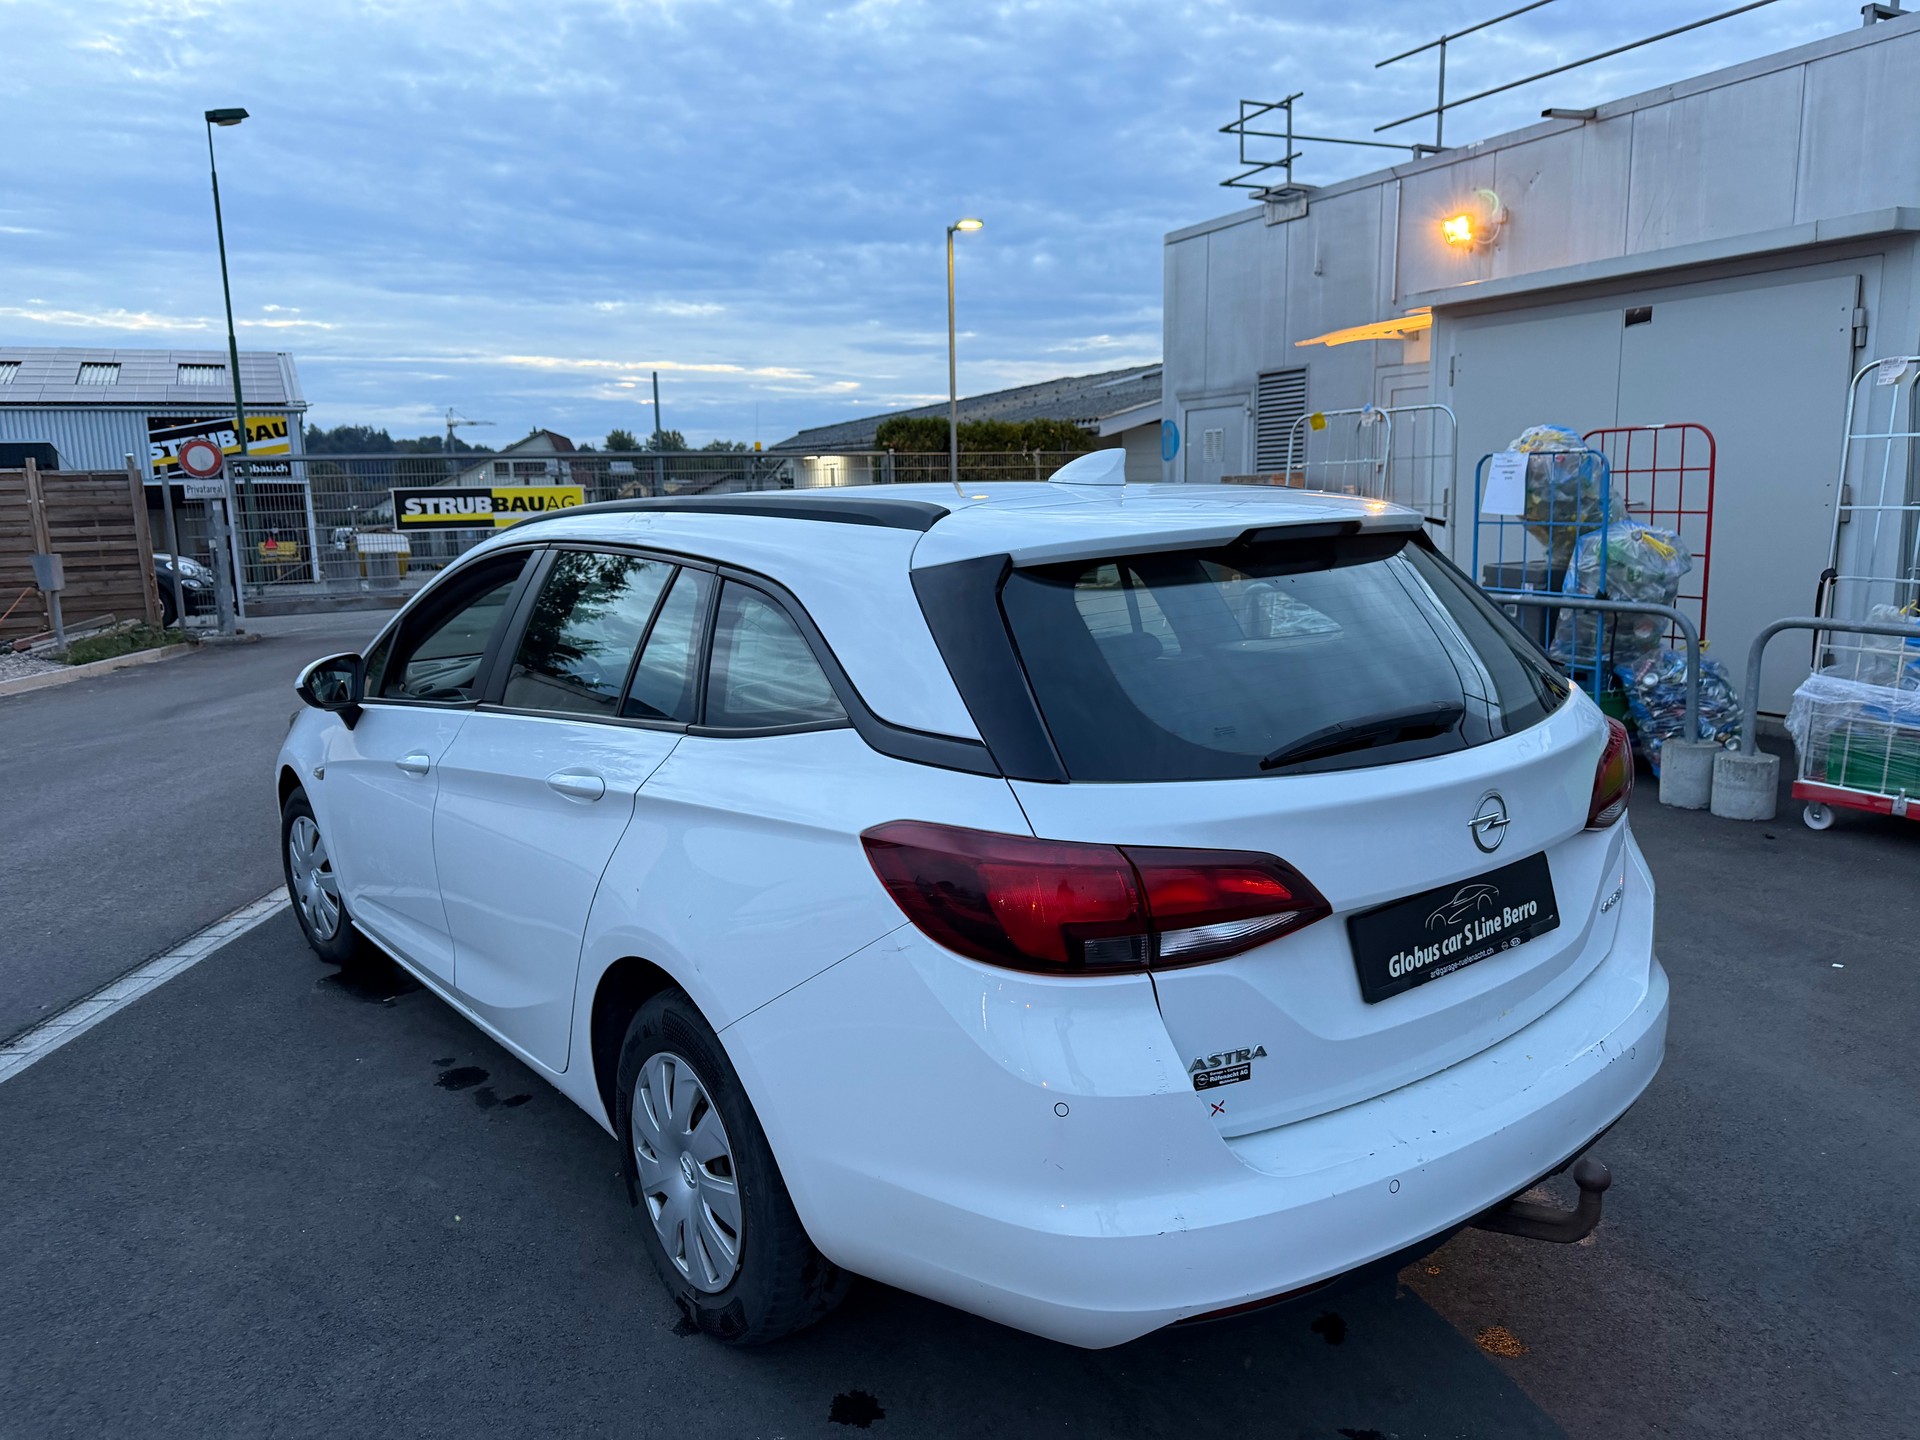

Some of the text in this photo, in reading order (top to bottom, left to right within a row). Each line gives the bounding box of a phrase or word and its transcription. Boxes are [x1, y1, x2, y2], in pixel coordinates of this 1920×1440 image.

[186, 484, 223, 496] Privatareal
[1388, 900, 1538, 978] Globus car S Line Berro
[1188, 1044, 1268, 1073] ASTRA
